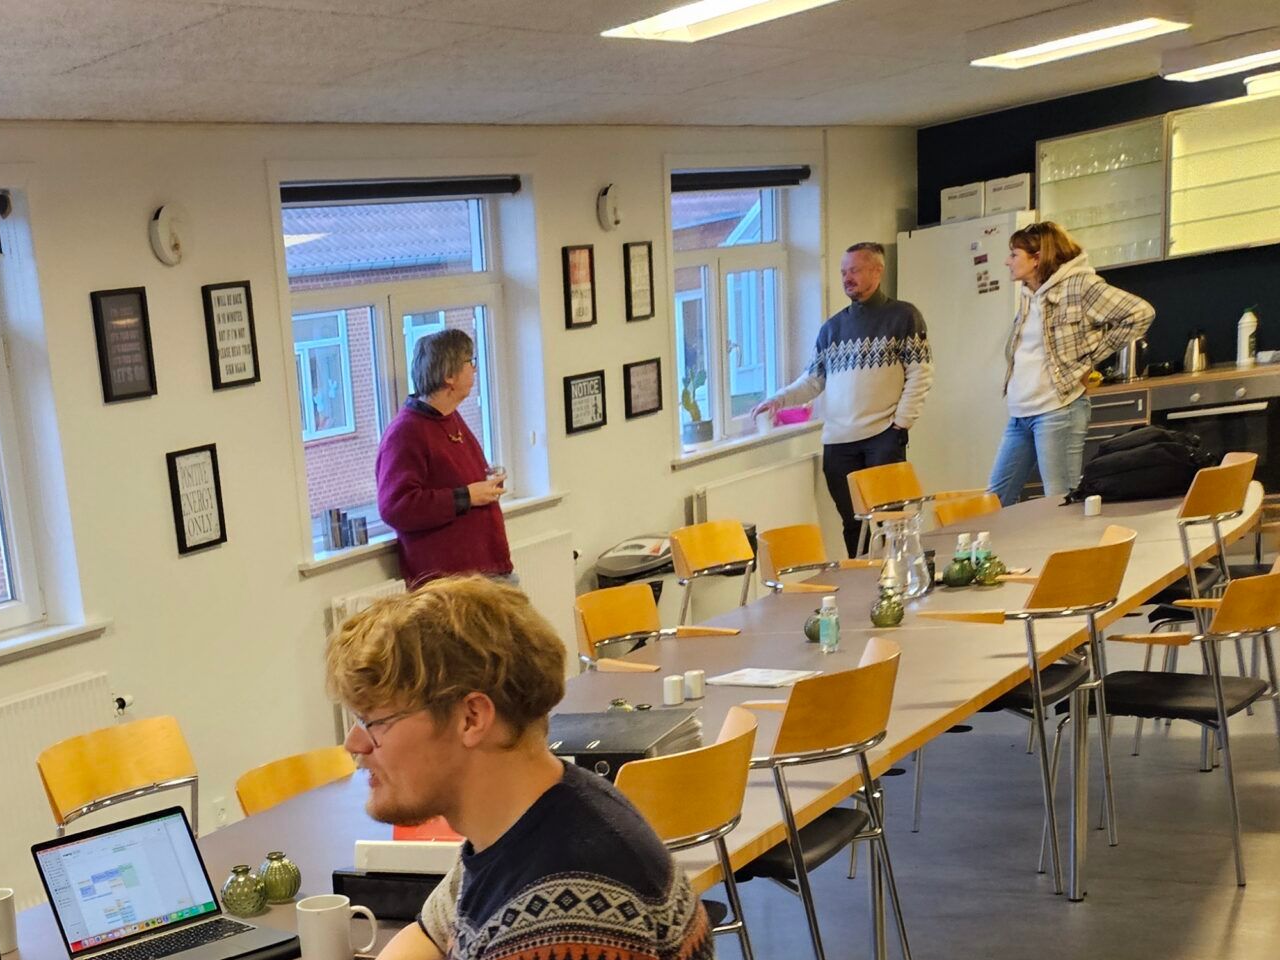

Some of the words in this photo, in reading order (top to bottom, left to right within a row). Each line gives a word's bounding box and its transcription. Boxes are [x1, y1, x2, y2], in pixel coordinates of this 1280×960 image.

[572, 379, 600, 399] NOTICE
[181, 488, 214, 516] ENERGY
[187, 513, 213, 537] ONLY
